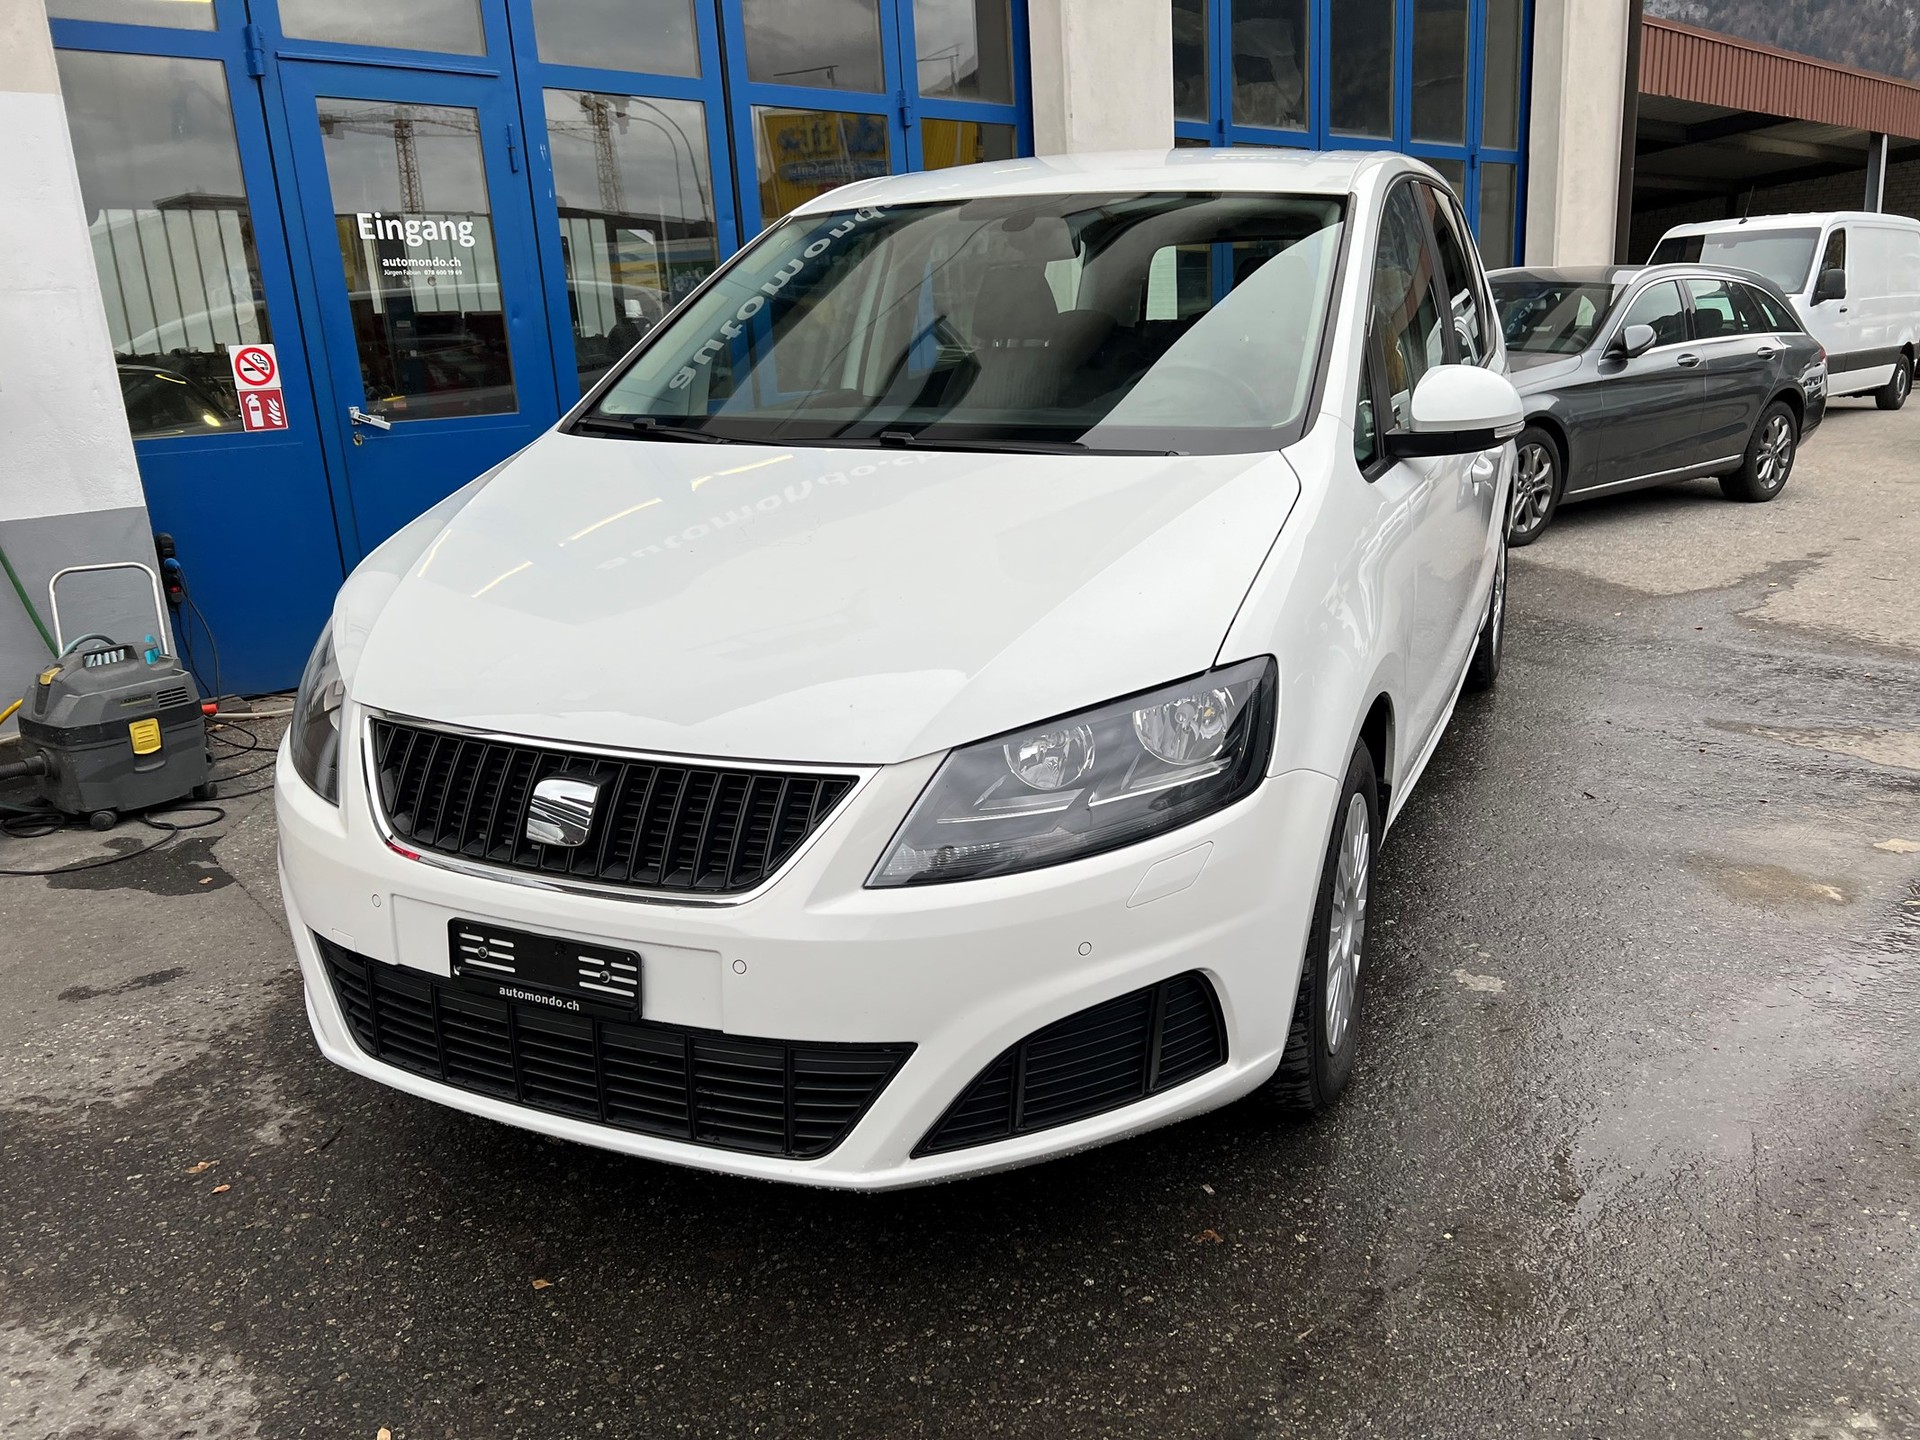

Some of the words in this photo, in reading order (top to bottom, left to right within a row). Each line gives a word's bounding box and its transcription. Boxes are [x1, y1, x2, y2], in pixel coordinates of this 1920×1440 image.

[356, 212, 476, 247] Eingang
[382, 257, 462, 267] automondo.ch
[499, 986, 580, 1011] automondo.ch
